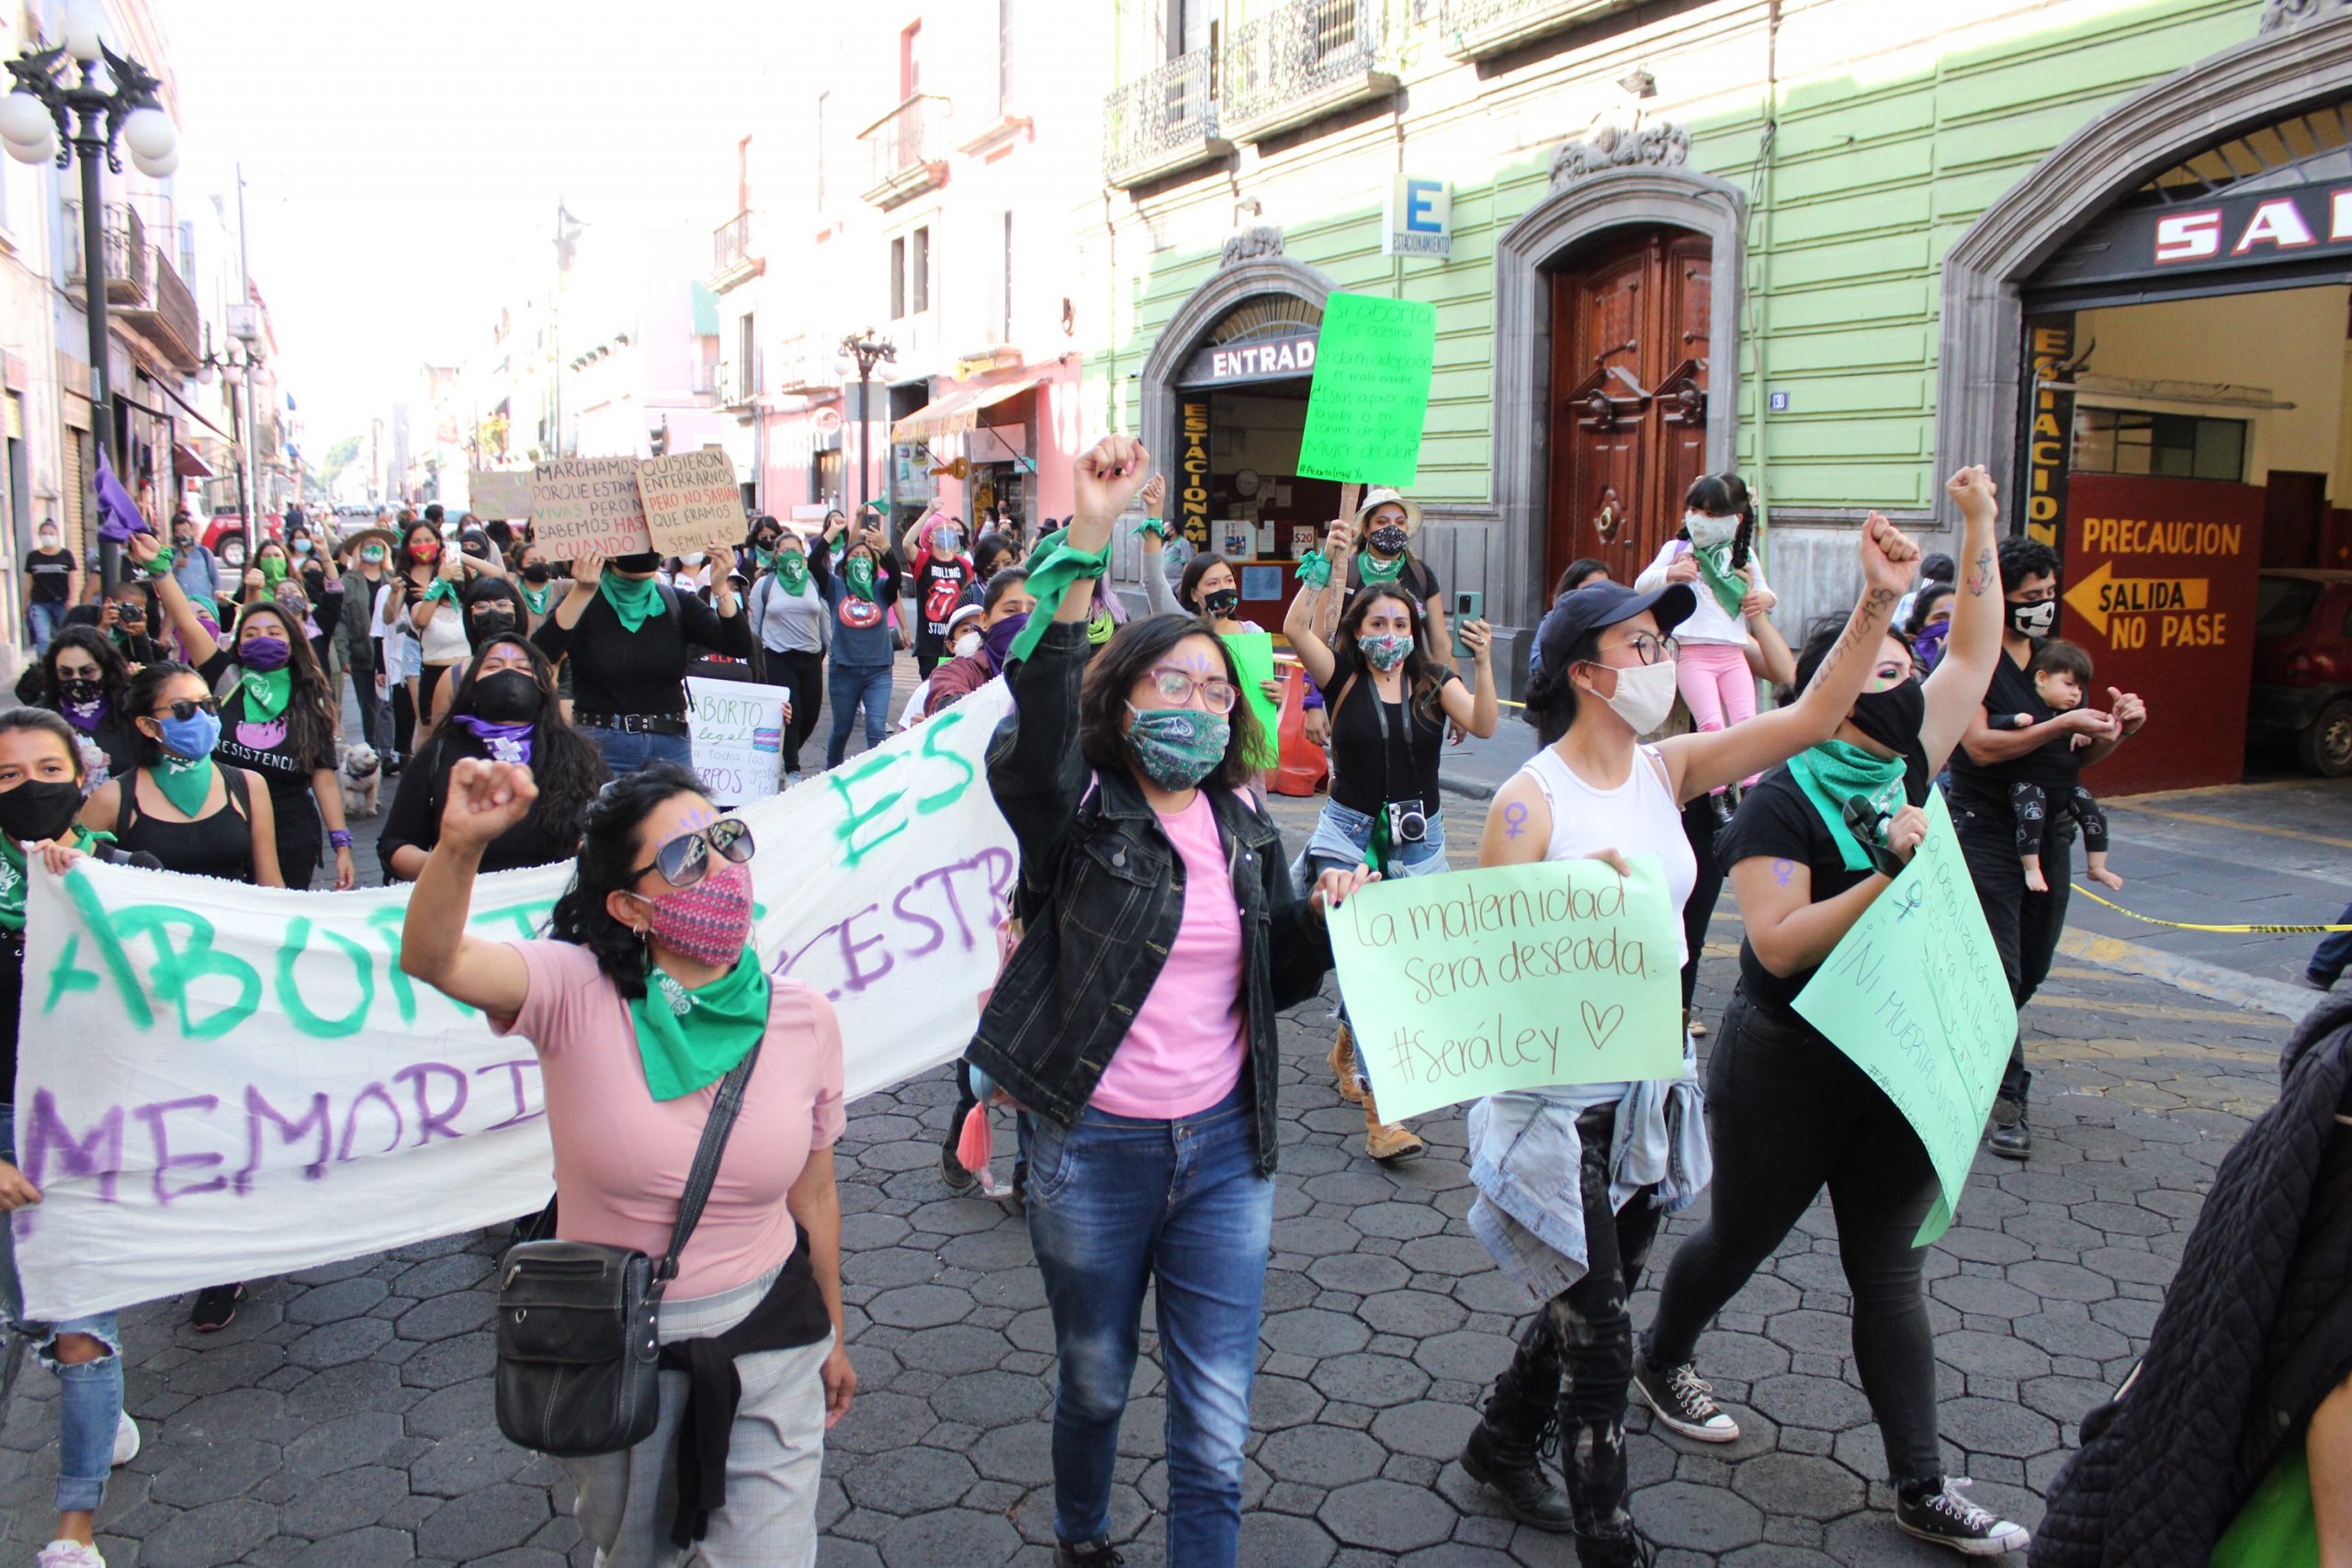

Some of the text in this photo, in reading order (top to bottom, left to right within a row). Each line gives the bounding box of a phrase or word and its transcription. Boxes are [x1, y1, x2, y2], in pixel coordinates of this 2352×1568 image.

[1407, 178, 1442, 233] E
[1393, 232, 1450, 254] ESTACIONAMIENTO
[1357, 301, 1432, 325] aborta
[1366, 324, 1413, 339] asesina
[1213, 339, 1317, 378] ENTRAD
[1333, 348, 1352, 365] da
[1350, 372, 1376, 382] mala
[1380, 374, 1413, 385] madre
[1314, 422, 1351, 434] contra
[536, 458, 639, 482] MARCHAMOS
[641, 450, 724, 478] QUISIERON
[645, 468, 734, 493] ENTERRARNOS
[533, 483, 590, 502] PORQUE
[649, 493, 679, 513] PERO
[684, 491, 702, 506] NO
[533, 505, 583, 521] VIVAS
[590, 499, 628, 516] PERO
[652, 511, 680, 528] QUE
[537, 514, 649, 541] SABEMOS HAST
[1295, 532, 1313, 543] $20
[2083, 518, 2242, 555] PRECAUCION
[555, 536, 636, 557] CUANDO
[669, 526, 735, 554] SEMILLAS
[931, 565, 962, 579] ROLLING
[2098, 581, 2187, 612] SALIDA
[2111, 613, 2227, 650] NO PASE
[688, 694, 763, 728] ABORTO
[698, 727, 748, 746] legal
[709, 749, 741, 761] todos
[748, 753, 764, 765] los
[829, 712, 974, 870] ES
[1408, 874, 1626, 941] maternidad
